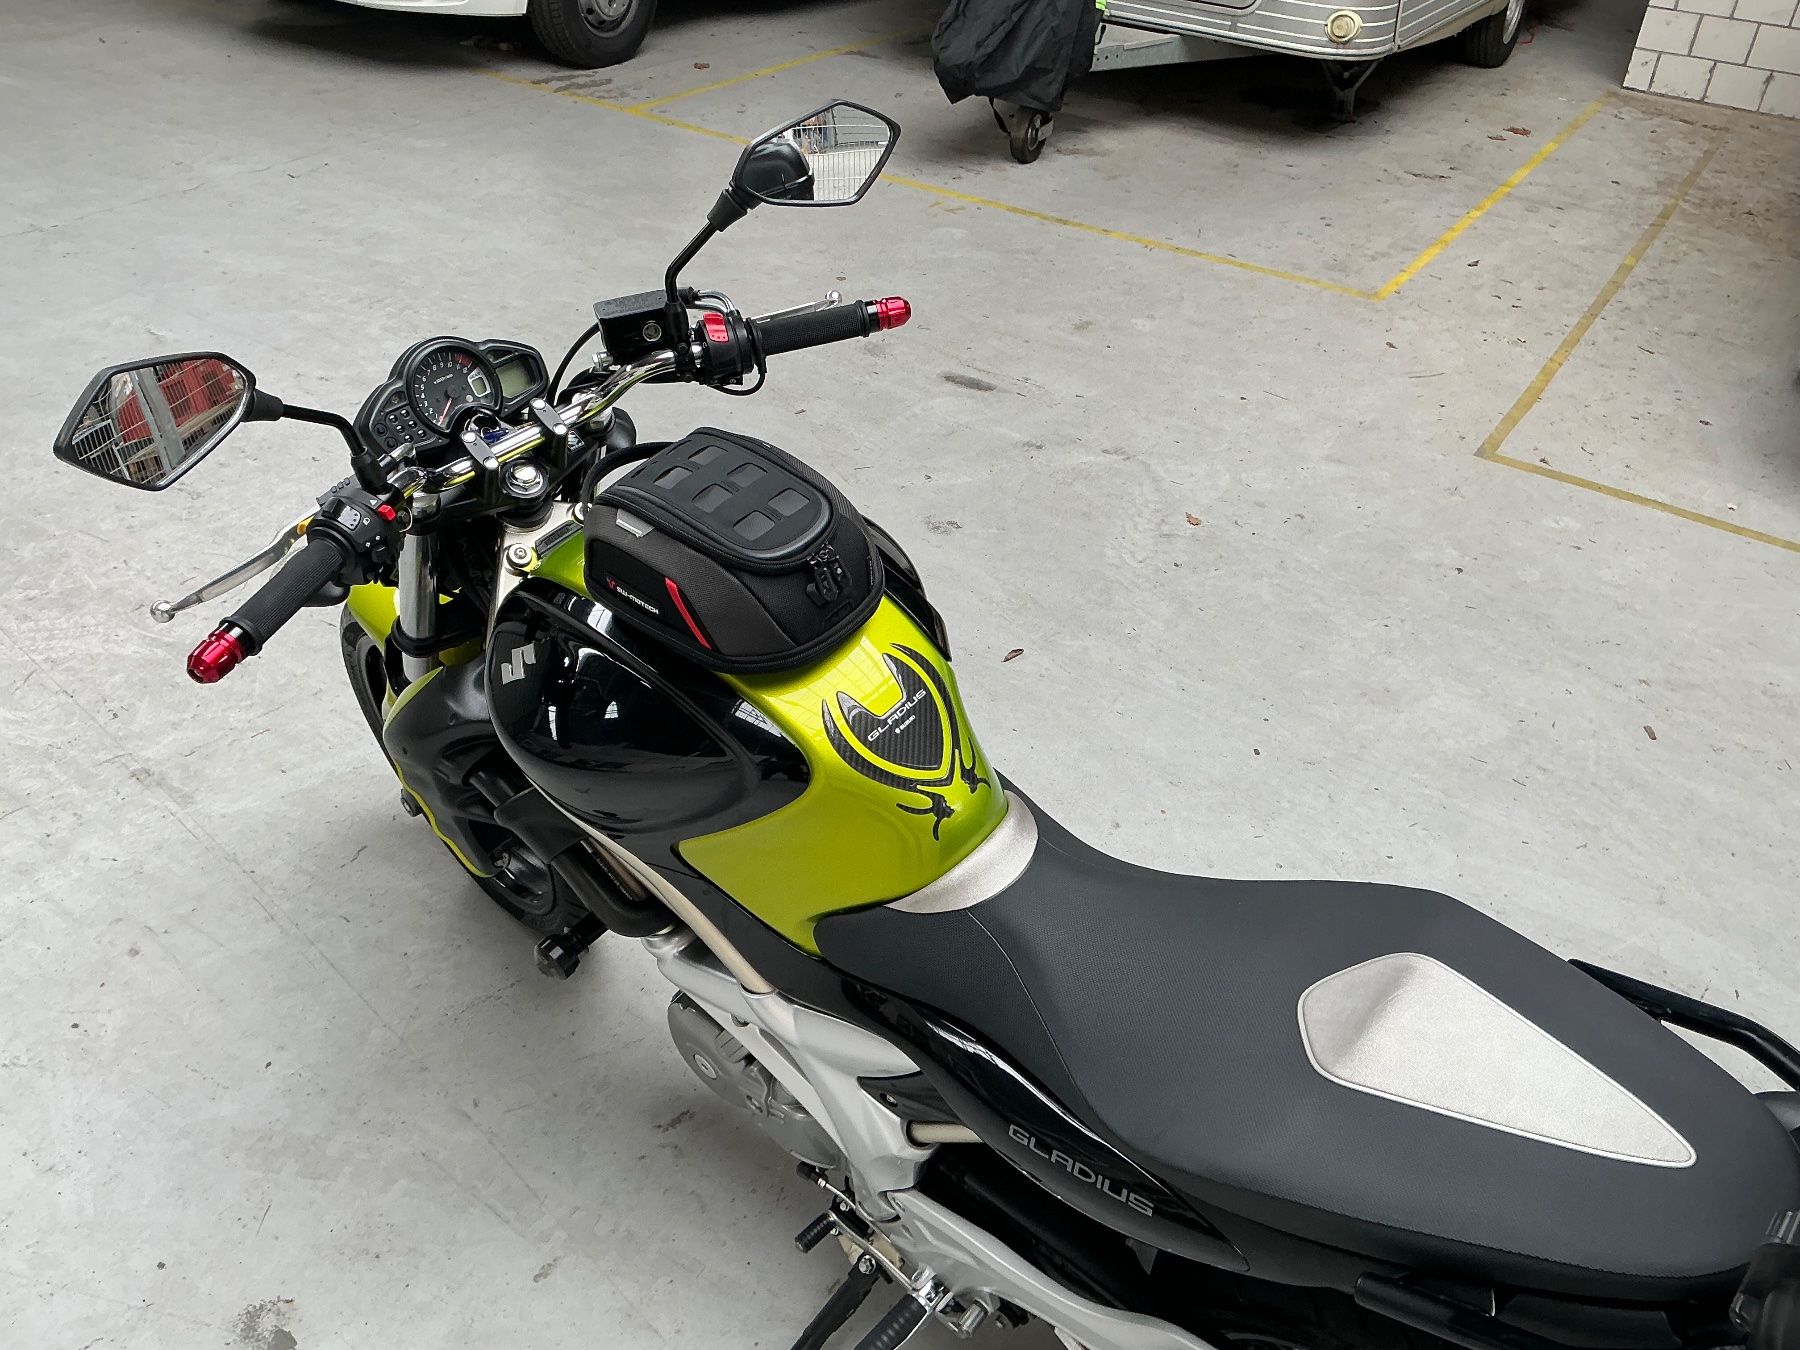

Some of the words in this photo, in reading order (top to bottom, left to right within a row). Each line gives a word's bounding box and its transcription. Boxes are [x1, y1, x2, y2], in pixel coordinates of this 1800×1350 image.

[616, 586, 659, 614] SW-MOTECH
[868, 689, 926, 741] GLADIUS
[1009, 1123, 1154, 1217] GLADIUS
